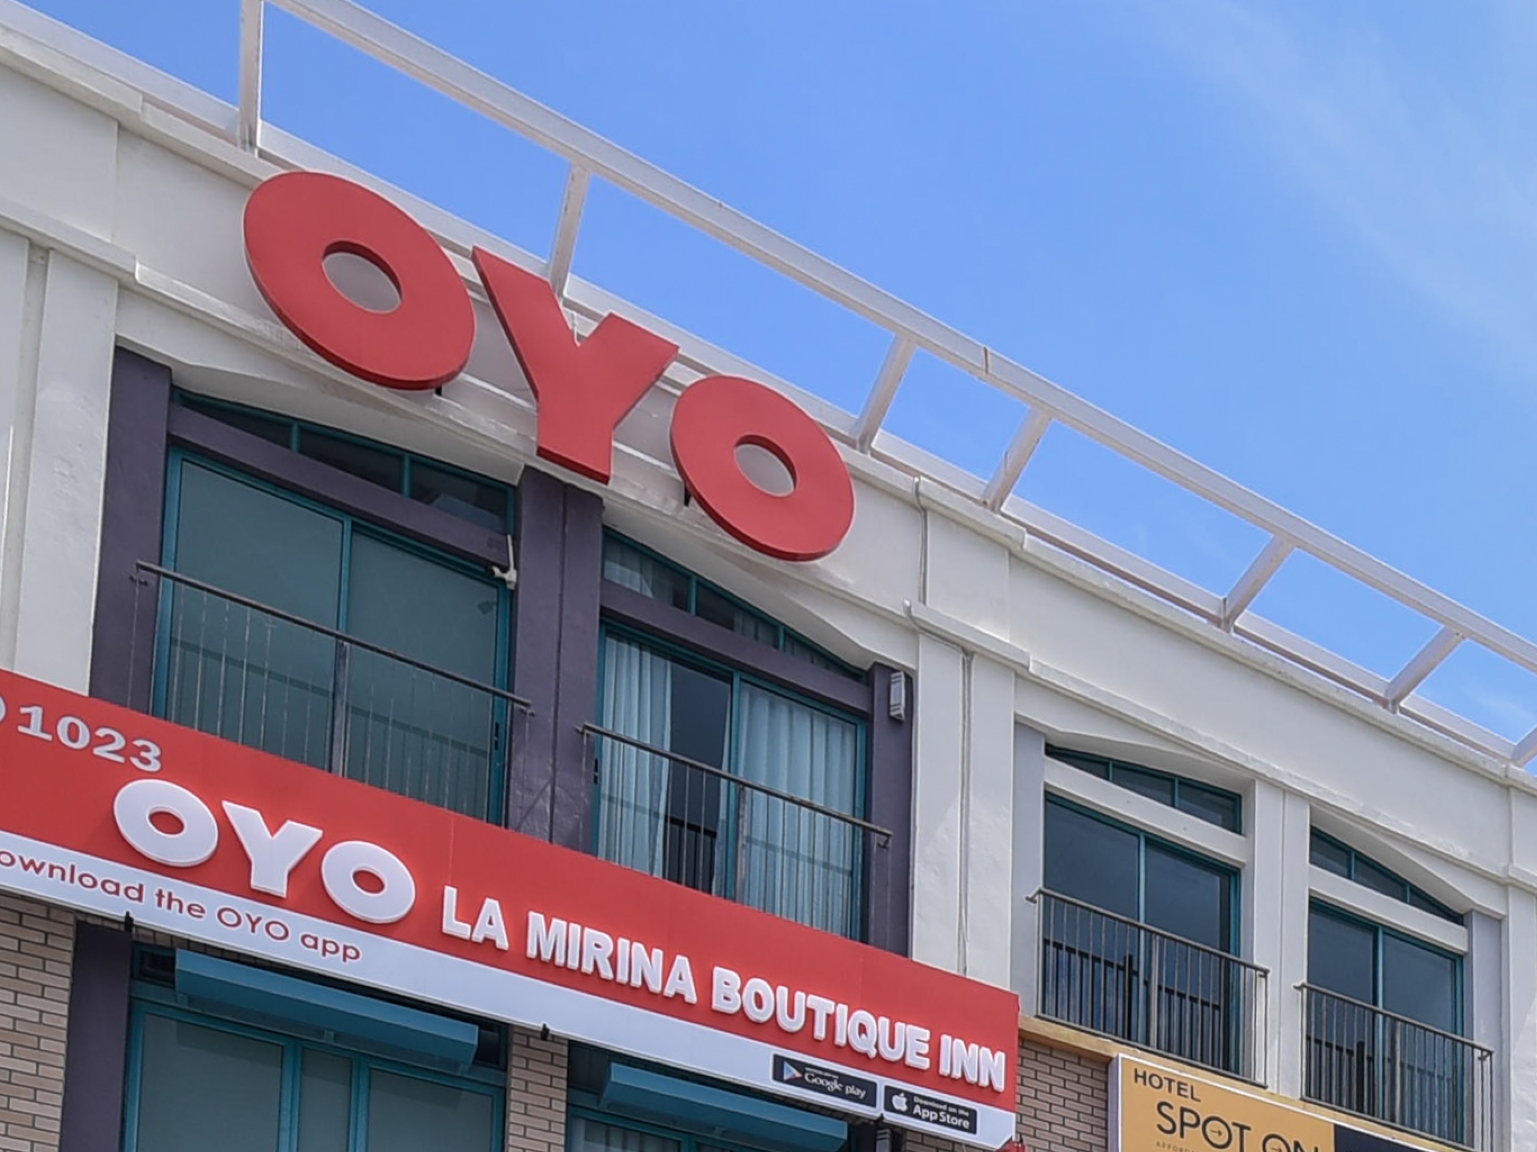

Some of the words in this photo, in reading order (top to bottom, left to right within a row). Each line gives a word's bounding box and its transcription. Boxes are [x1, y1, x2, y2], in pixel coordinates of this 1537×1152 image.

[243, 170, 855, 563] OYO
[17, 705, 162, 772] 1023
[113, 778, 416, 924] OYO
[441, 885, 509, 951] LA
[526, 910, 699, 1005] MIRINA
[711, 965, 931, 1071] BOUTIQUE
[938, 1033, 1006, 1093] INN
[155, 887, 207, 921] the
[216, 906, 291, 942] OYO
[299, 929, 362, 965] app
[804, 1072, 843, 1093] Google
[845, 1083, 867, 1099] play
[913, 1105, 938, 1122] App
[938, 1111, 970, 1129] Store
[1133, 1067, 1201, 1103] HOTEL
